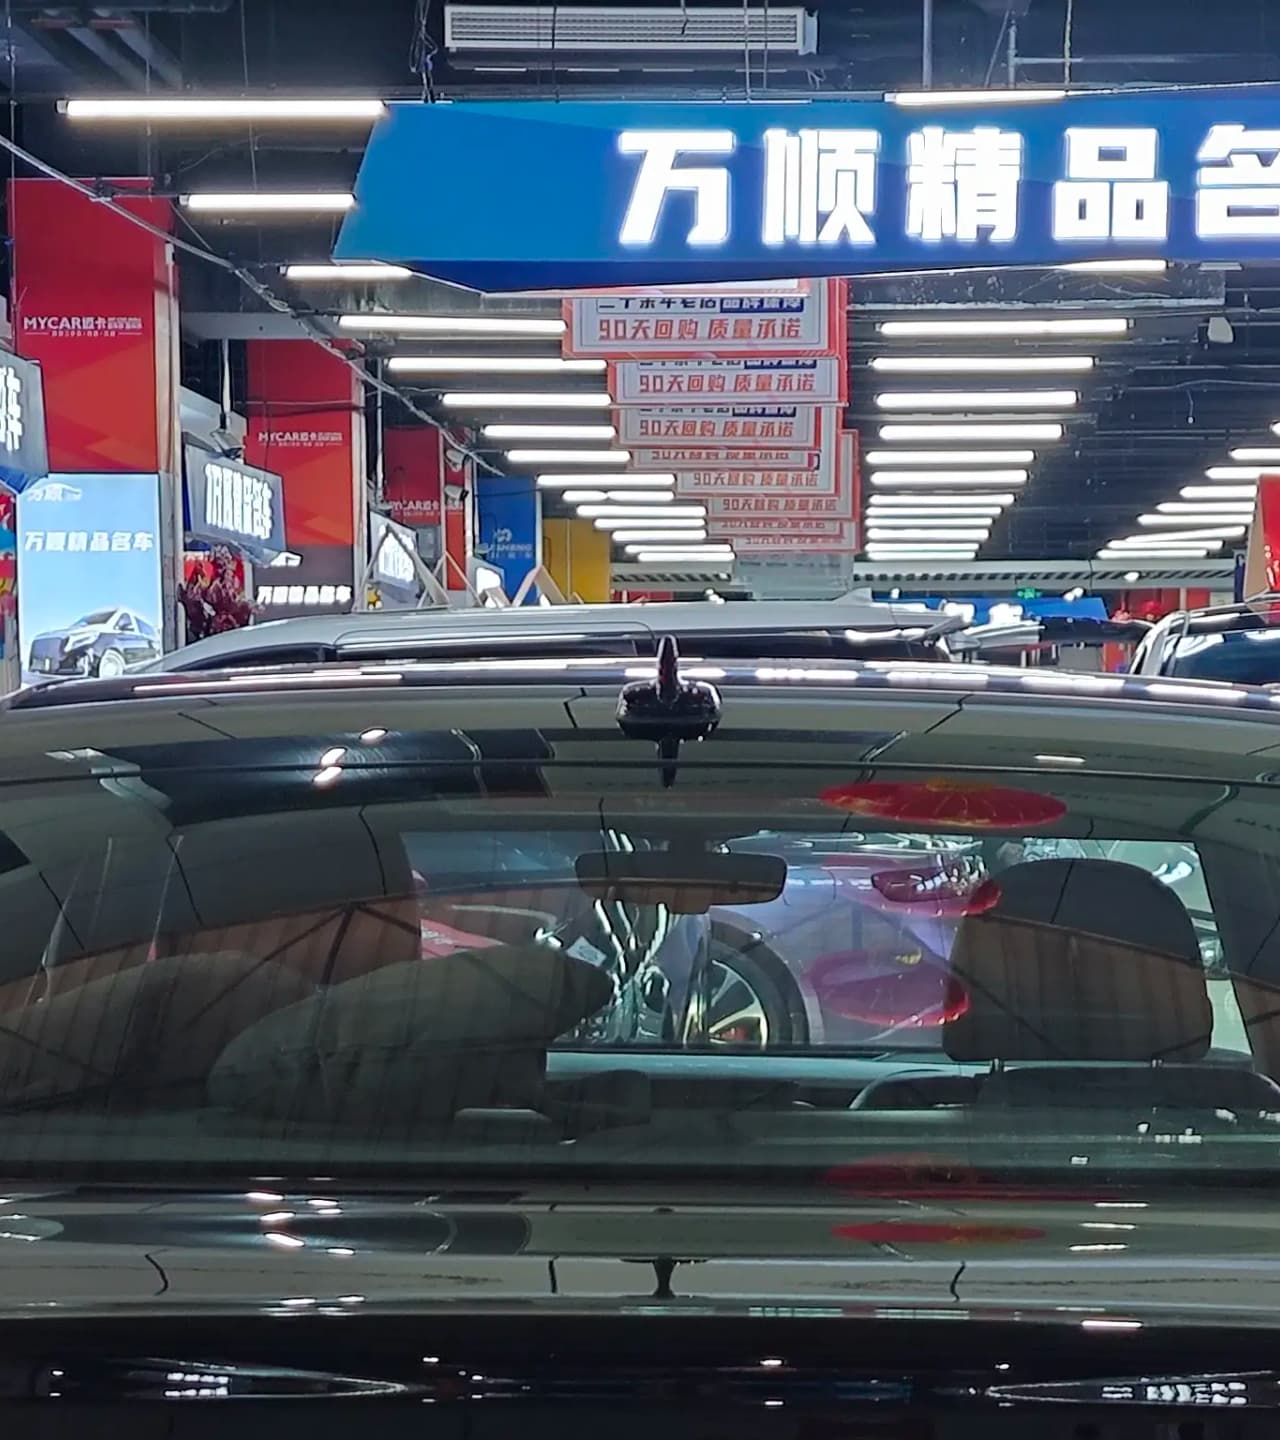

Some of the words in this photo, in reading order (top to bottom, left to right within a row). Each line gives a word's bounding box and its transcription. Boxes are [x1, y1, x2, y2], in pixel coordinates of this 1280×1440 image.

[598, 319, 698, 341] 90天回购
[708, 318, 802, 339] 质量承诺
[639, 374, 724, 393] 90天回购
[734, 373, 816, 392] 质量承诺
[639, 421, 716, 438] 90天回购
[723, 420, 794, 437] 质量承诺
